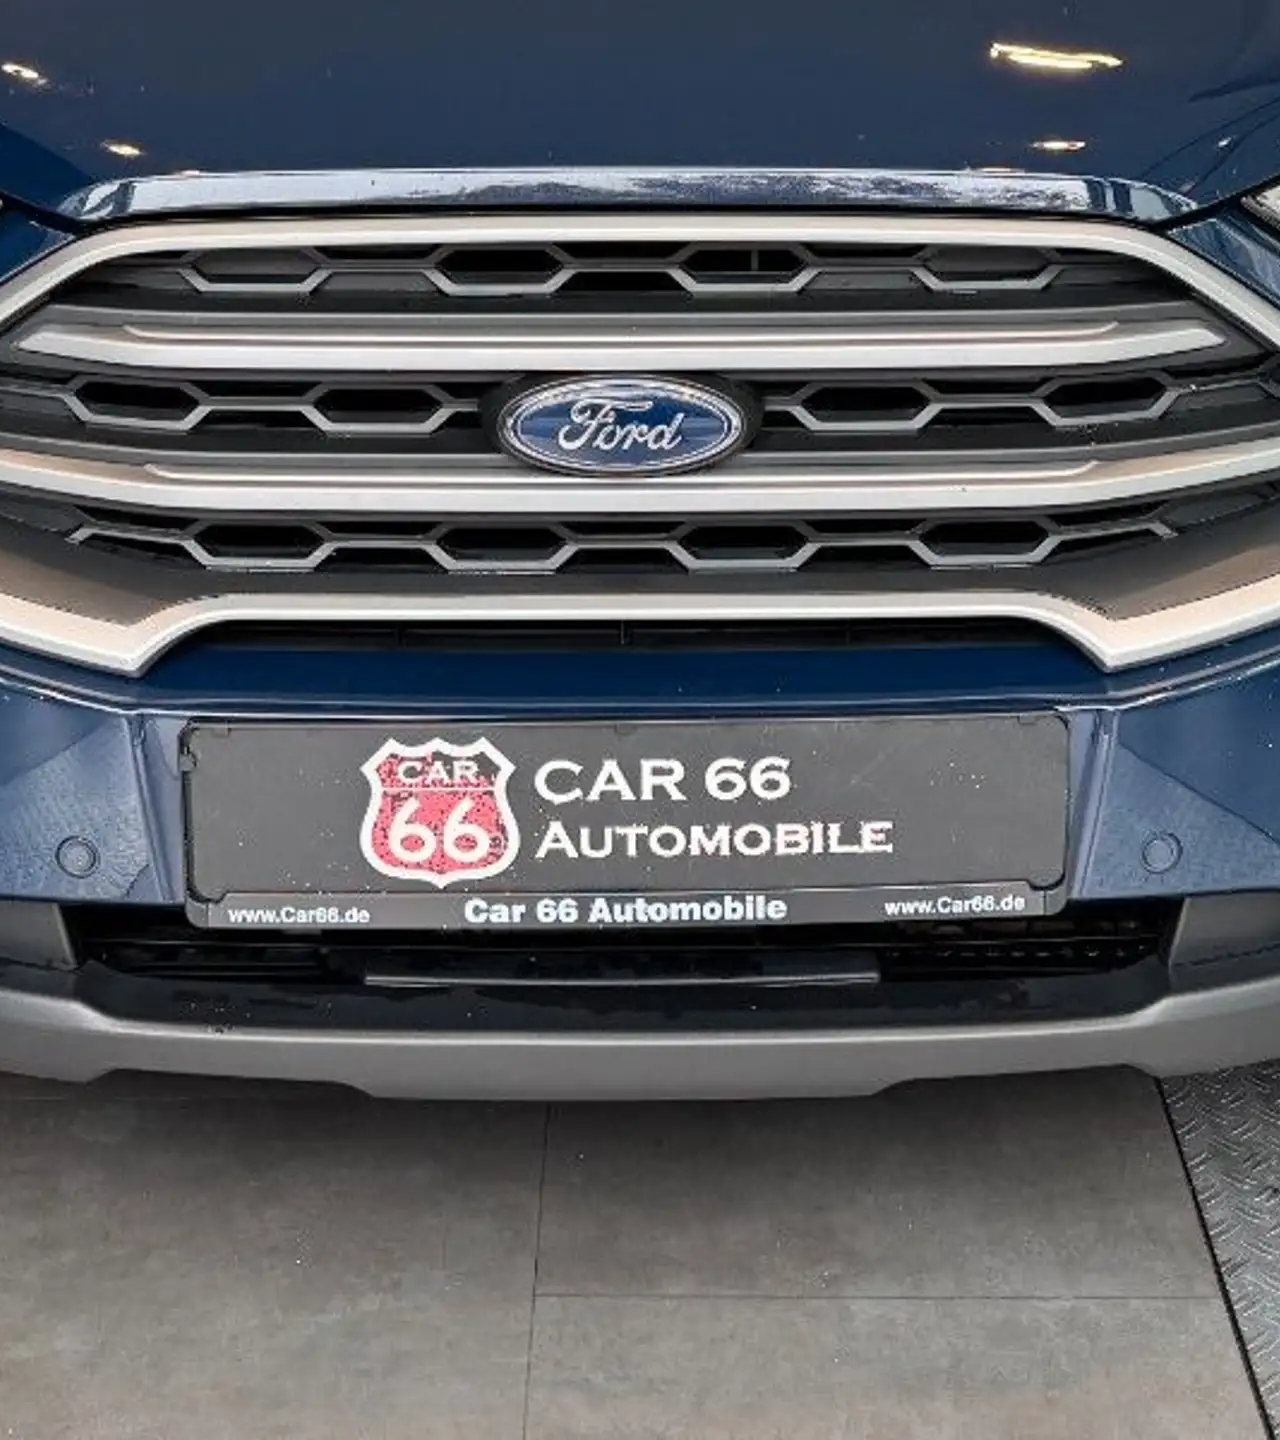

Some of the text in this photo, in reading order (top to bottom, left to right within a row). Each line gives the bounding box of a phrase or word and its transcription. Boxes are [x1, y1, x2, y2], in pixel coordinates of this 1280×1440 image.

[558, 398, 684, 451] Ford
[398, 759, 479, 784] CAR
[534, 756, 791, 803] CAR 66
[389, 797, 490, 863] 66
[228, 906, 370, 923] www.Car66.de
[464, 895, 787, 923] Car 66 Automobile
[884, 894, 1025, 915] www.Car66.de
